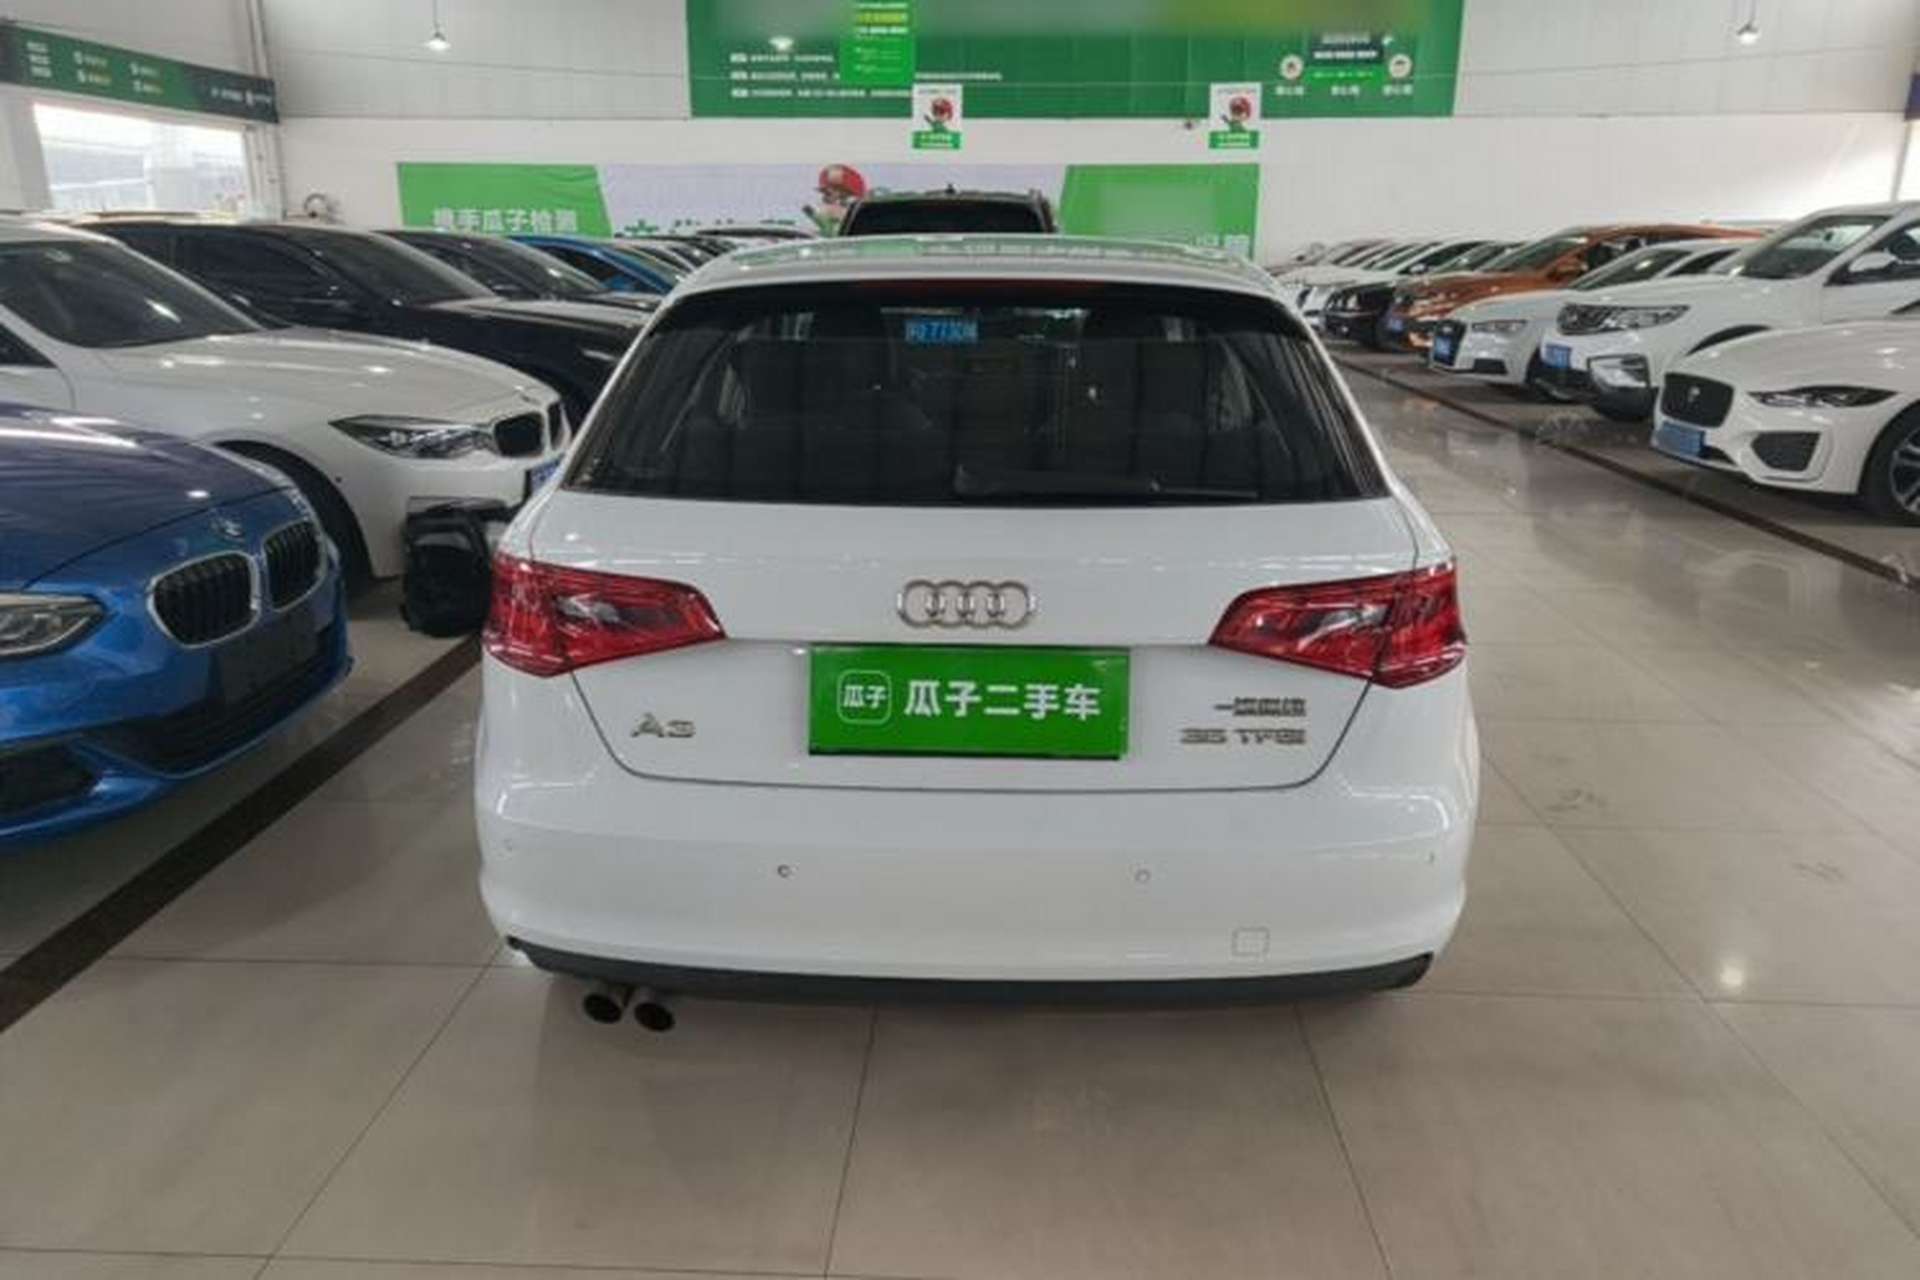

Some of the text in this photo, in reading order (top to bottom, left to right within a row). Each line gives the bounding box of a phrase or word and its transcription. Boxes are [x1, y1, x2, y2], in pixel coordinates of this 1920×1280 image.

[843, 685, 886, 708] 瓜子
[904, 680, 1100, 720] 瓜子二手车
[631, 712, 696, 739] A3
